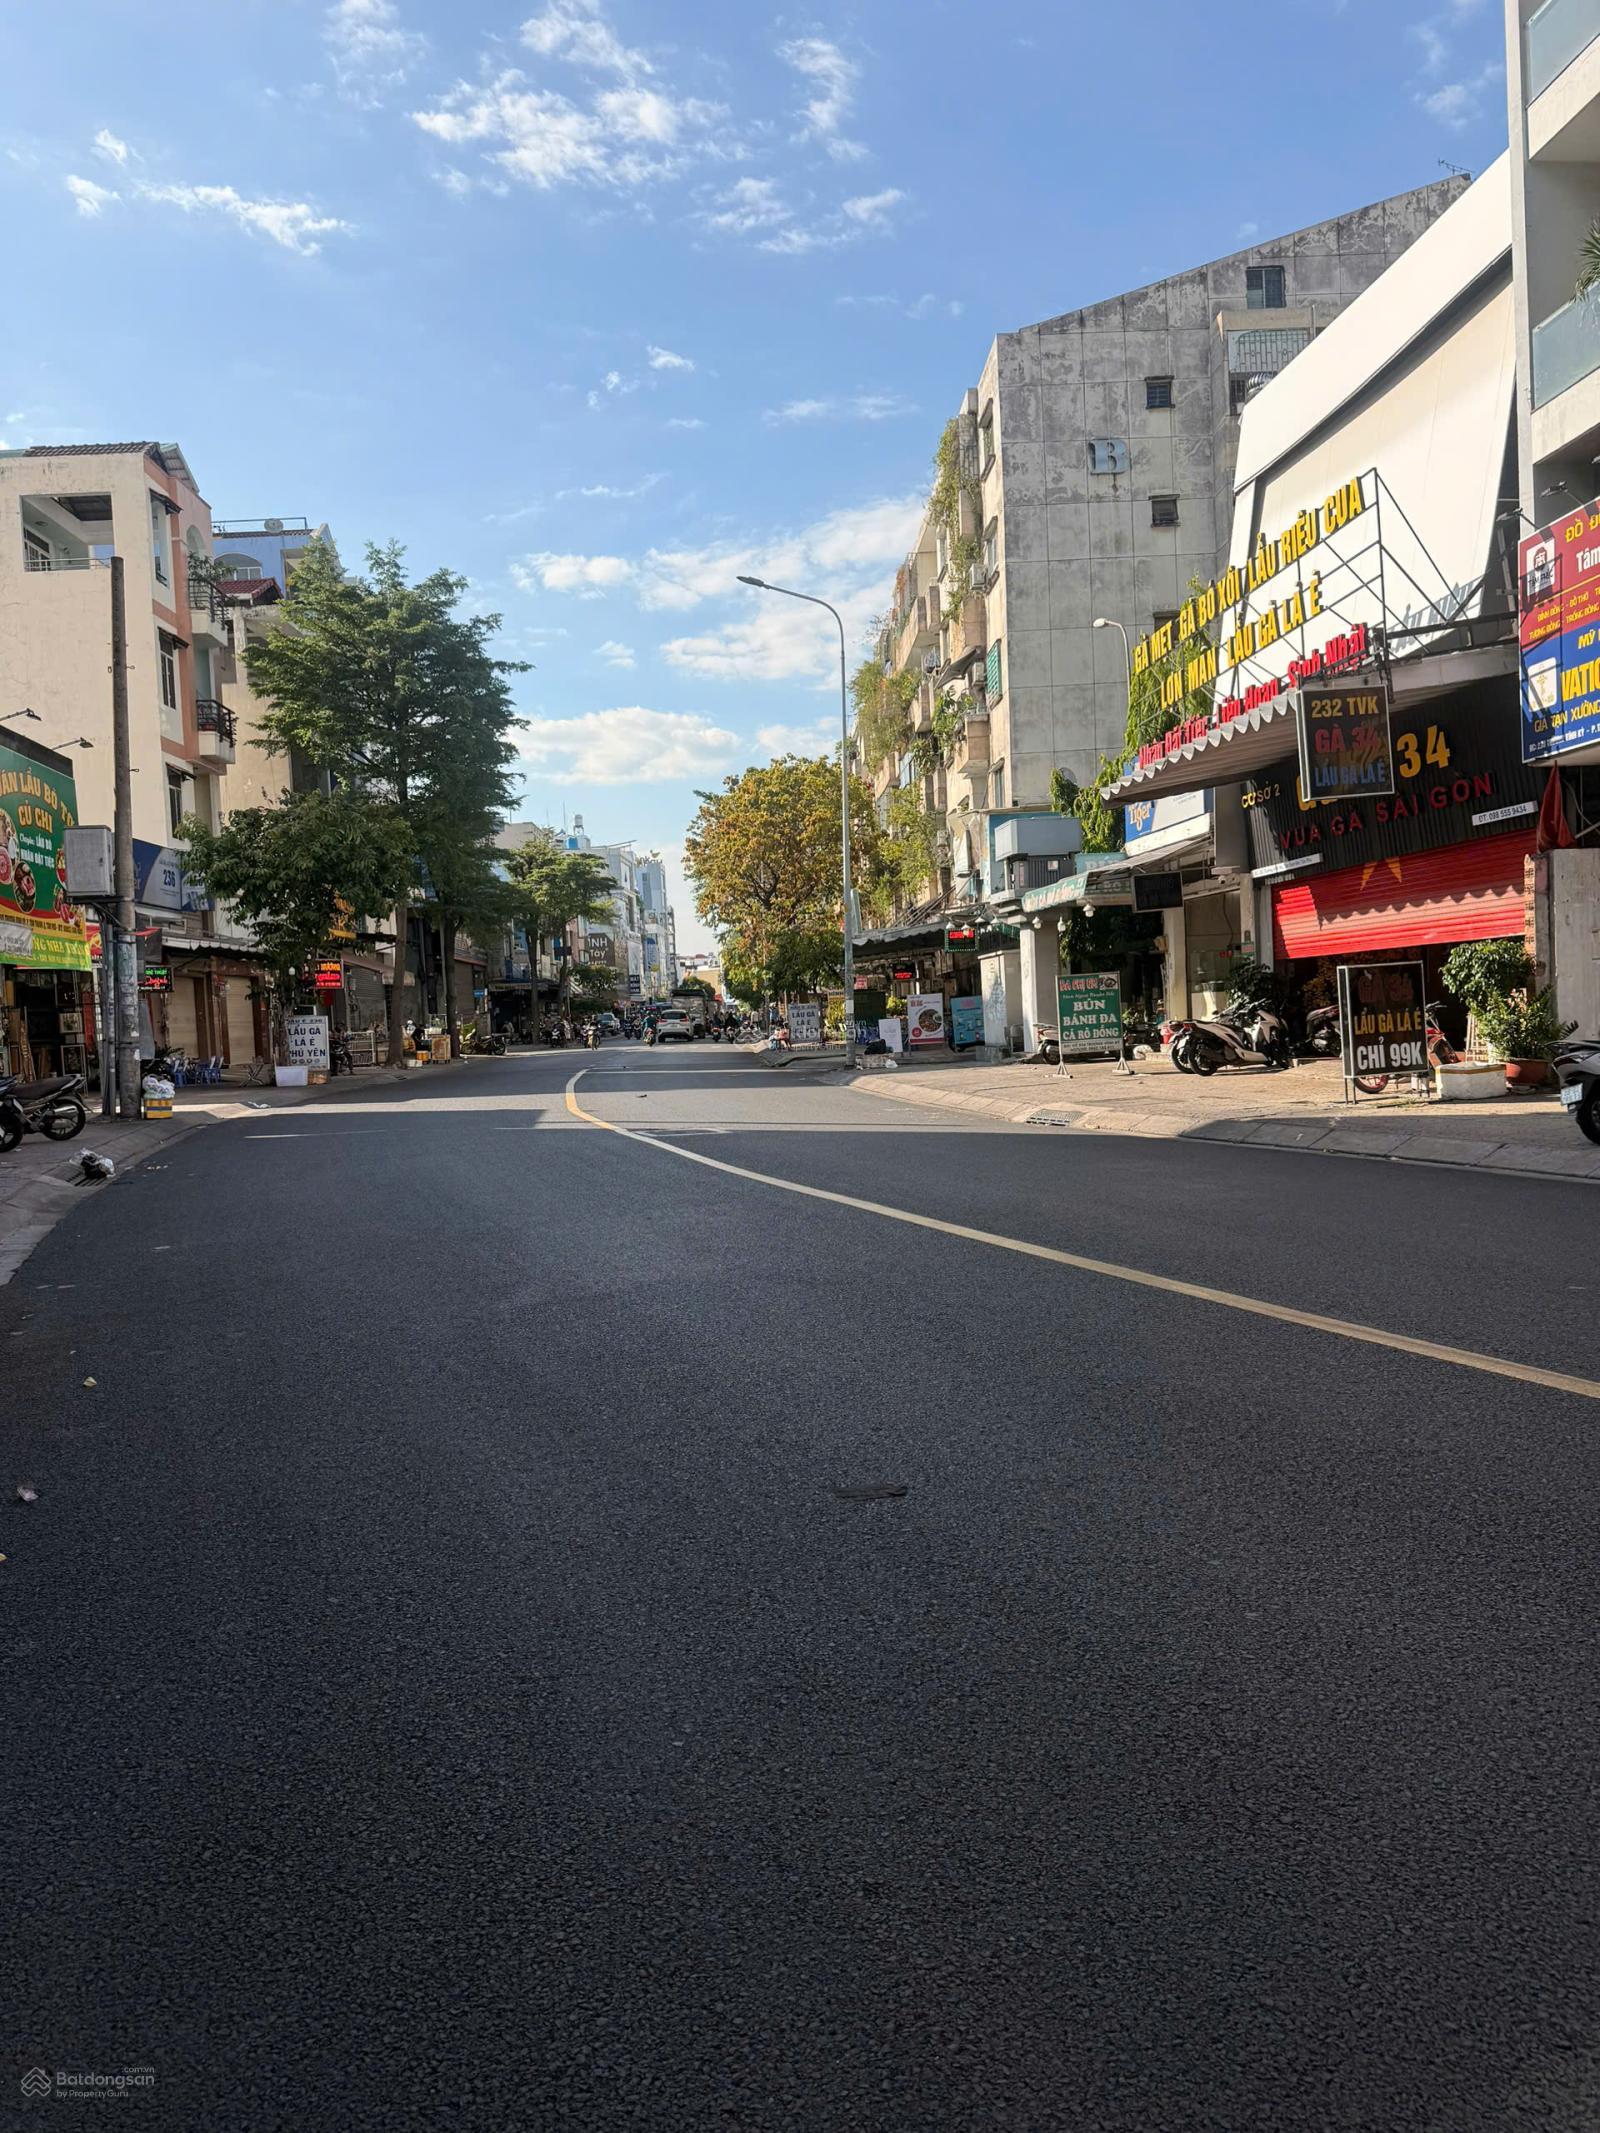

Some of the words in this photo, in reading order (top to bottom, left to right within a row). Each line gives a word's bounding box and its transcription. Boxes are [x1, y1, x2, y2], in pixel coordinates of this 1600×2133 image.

[1324, 477, 1362, 534] CUA
[1311, 698, 1343, 719] 232
[1346, 696, 1379, 716] TVK
[1315, 723, 1345, 753] GÀ
[1396, 725, 1450, 778] 34
[19, 766, 41, 797] LẨU
[43, 782, 58, 810] BÒ
[1273, 783, 1281, 797] 2
[1429, 771, 1493, 809] GÒN
[35, 806, 53, 834] CHI
[1063, 1013, 1097, 1026] BÁNH
[1073, 998, 1106, 1012] BÚN
[1062, 1028, 1076, 1040] CÁ
[1077, 1027, 1091, 1039] RÔ
[1354, 1006, 1376, 1036] LẨU
[1378, 1009, 1395, 1033] GÀ
[1396, 1007, 1412, 1032] LÁ
[307, 1047, 326, 1058] YÊN
[1356, 1035, 1387, 1071] CHỈ
[1389, 1041, 1424, 1068] 99K
